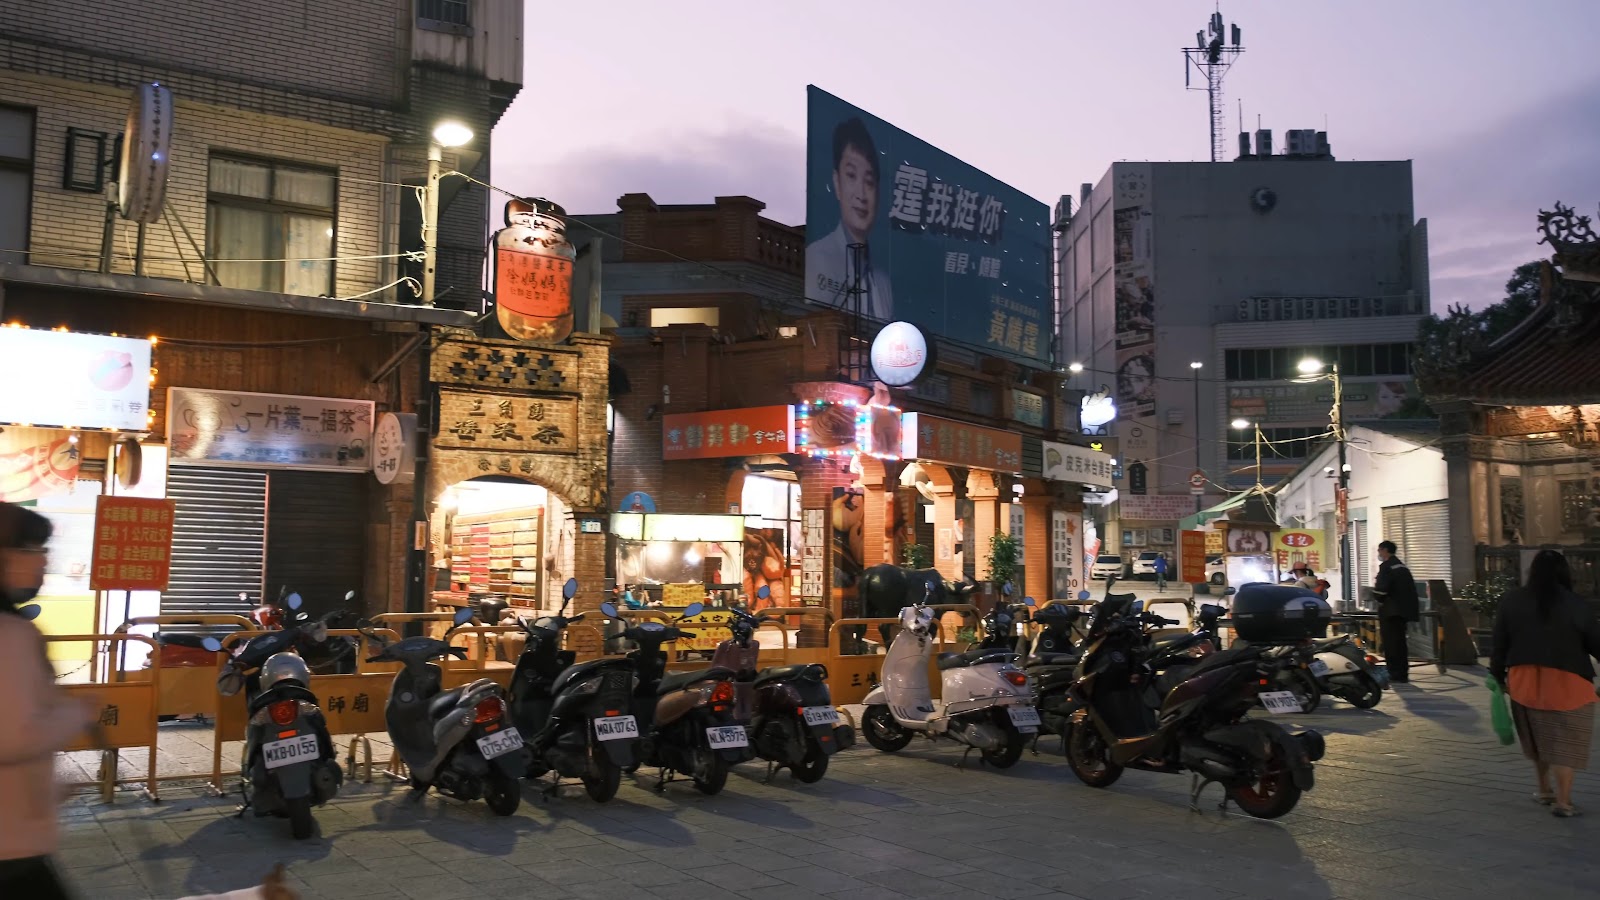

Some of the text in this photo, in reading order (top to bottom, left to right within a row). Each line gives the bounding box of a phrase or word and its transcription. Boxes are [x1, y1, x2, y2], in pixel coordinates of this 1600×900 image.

[889, 164, 1003, 236] 霆我挺你
[246, 404, 356, 434] 一片葉一福茶
[98, 704, 119, 726] 廟
[265, 740, 316, 762] MXB-0155
